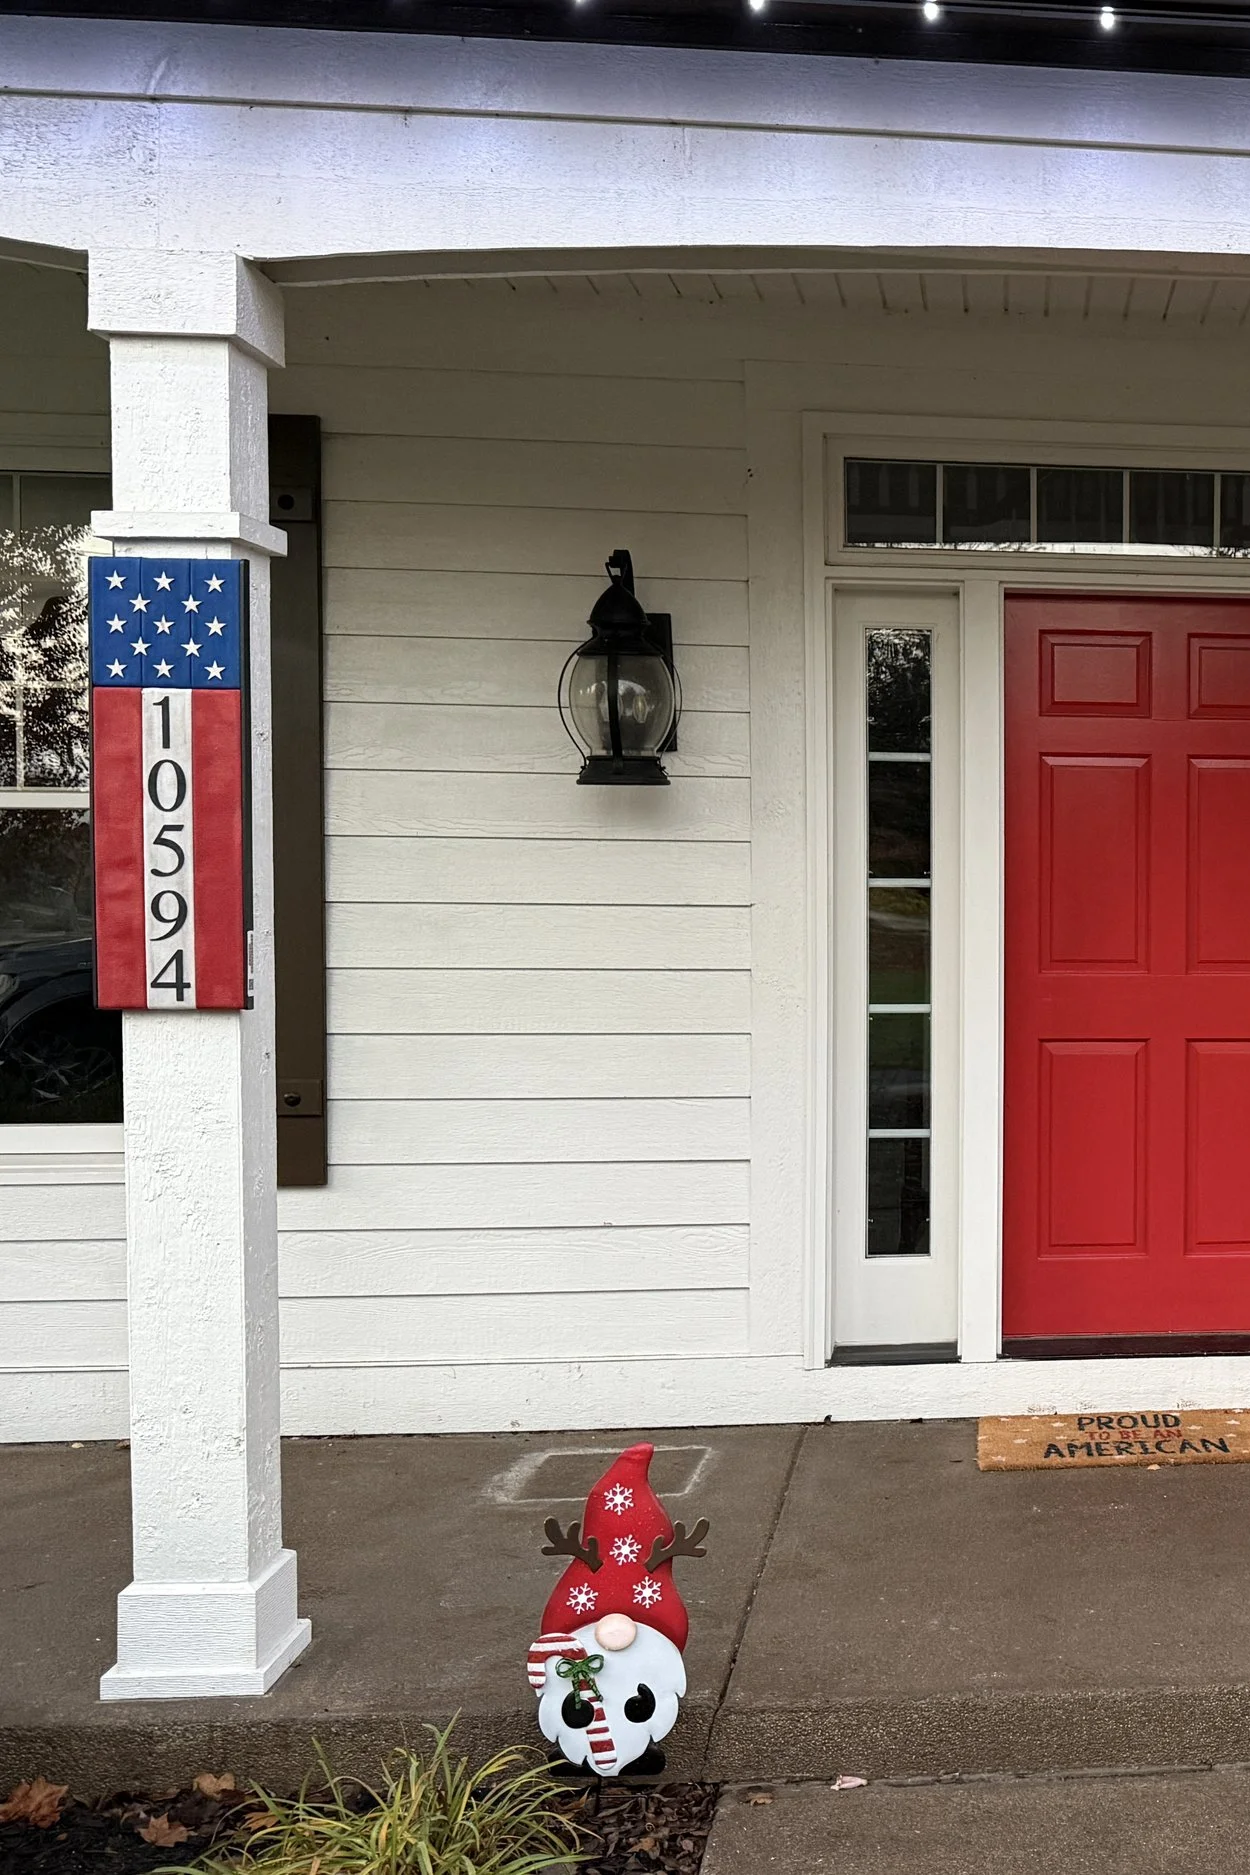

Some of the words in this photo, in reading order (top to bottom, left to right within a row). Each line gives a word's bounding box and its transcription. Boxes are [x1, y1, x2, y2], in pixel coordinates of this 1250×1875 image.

[147, 695, 192, 1003] 10594
[1076, 1413, 1181, 1431] PROUD
[1086, 1431, 1111, 1441] TO
[1120, 1429, 1143, 1440] BE
[1153, 1429, 1184, 1440] AN
[1044, 1438, 1231, 1458] AMERICAN
